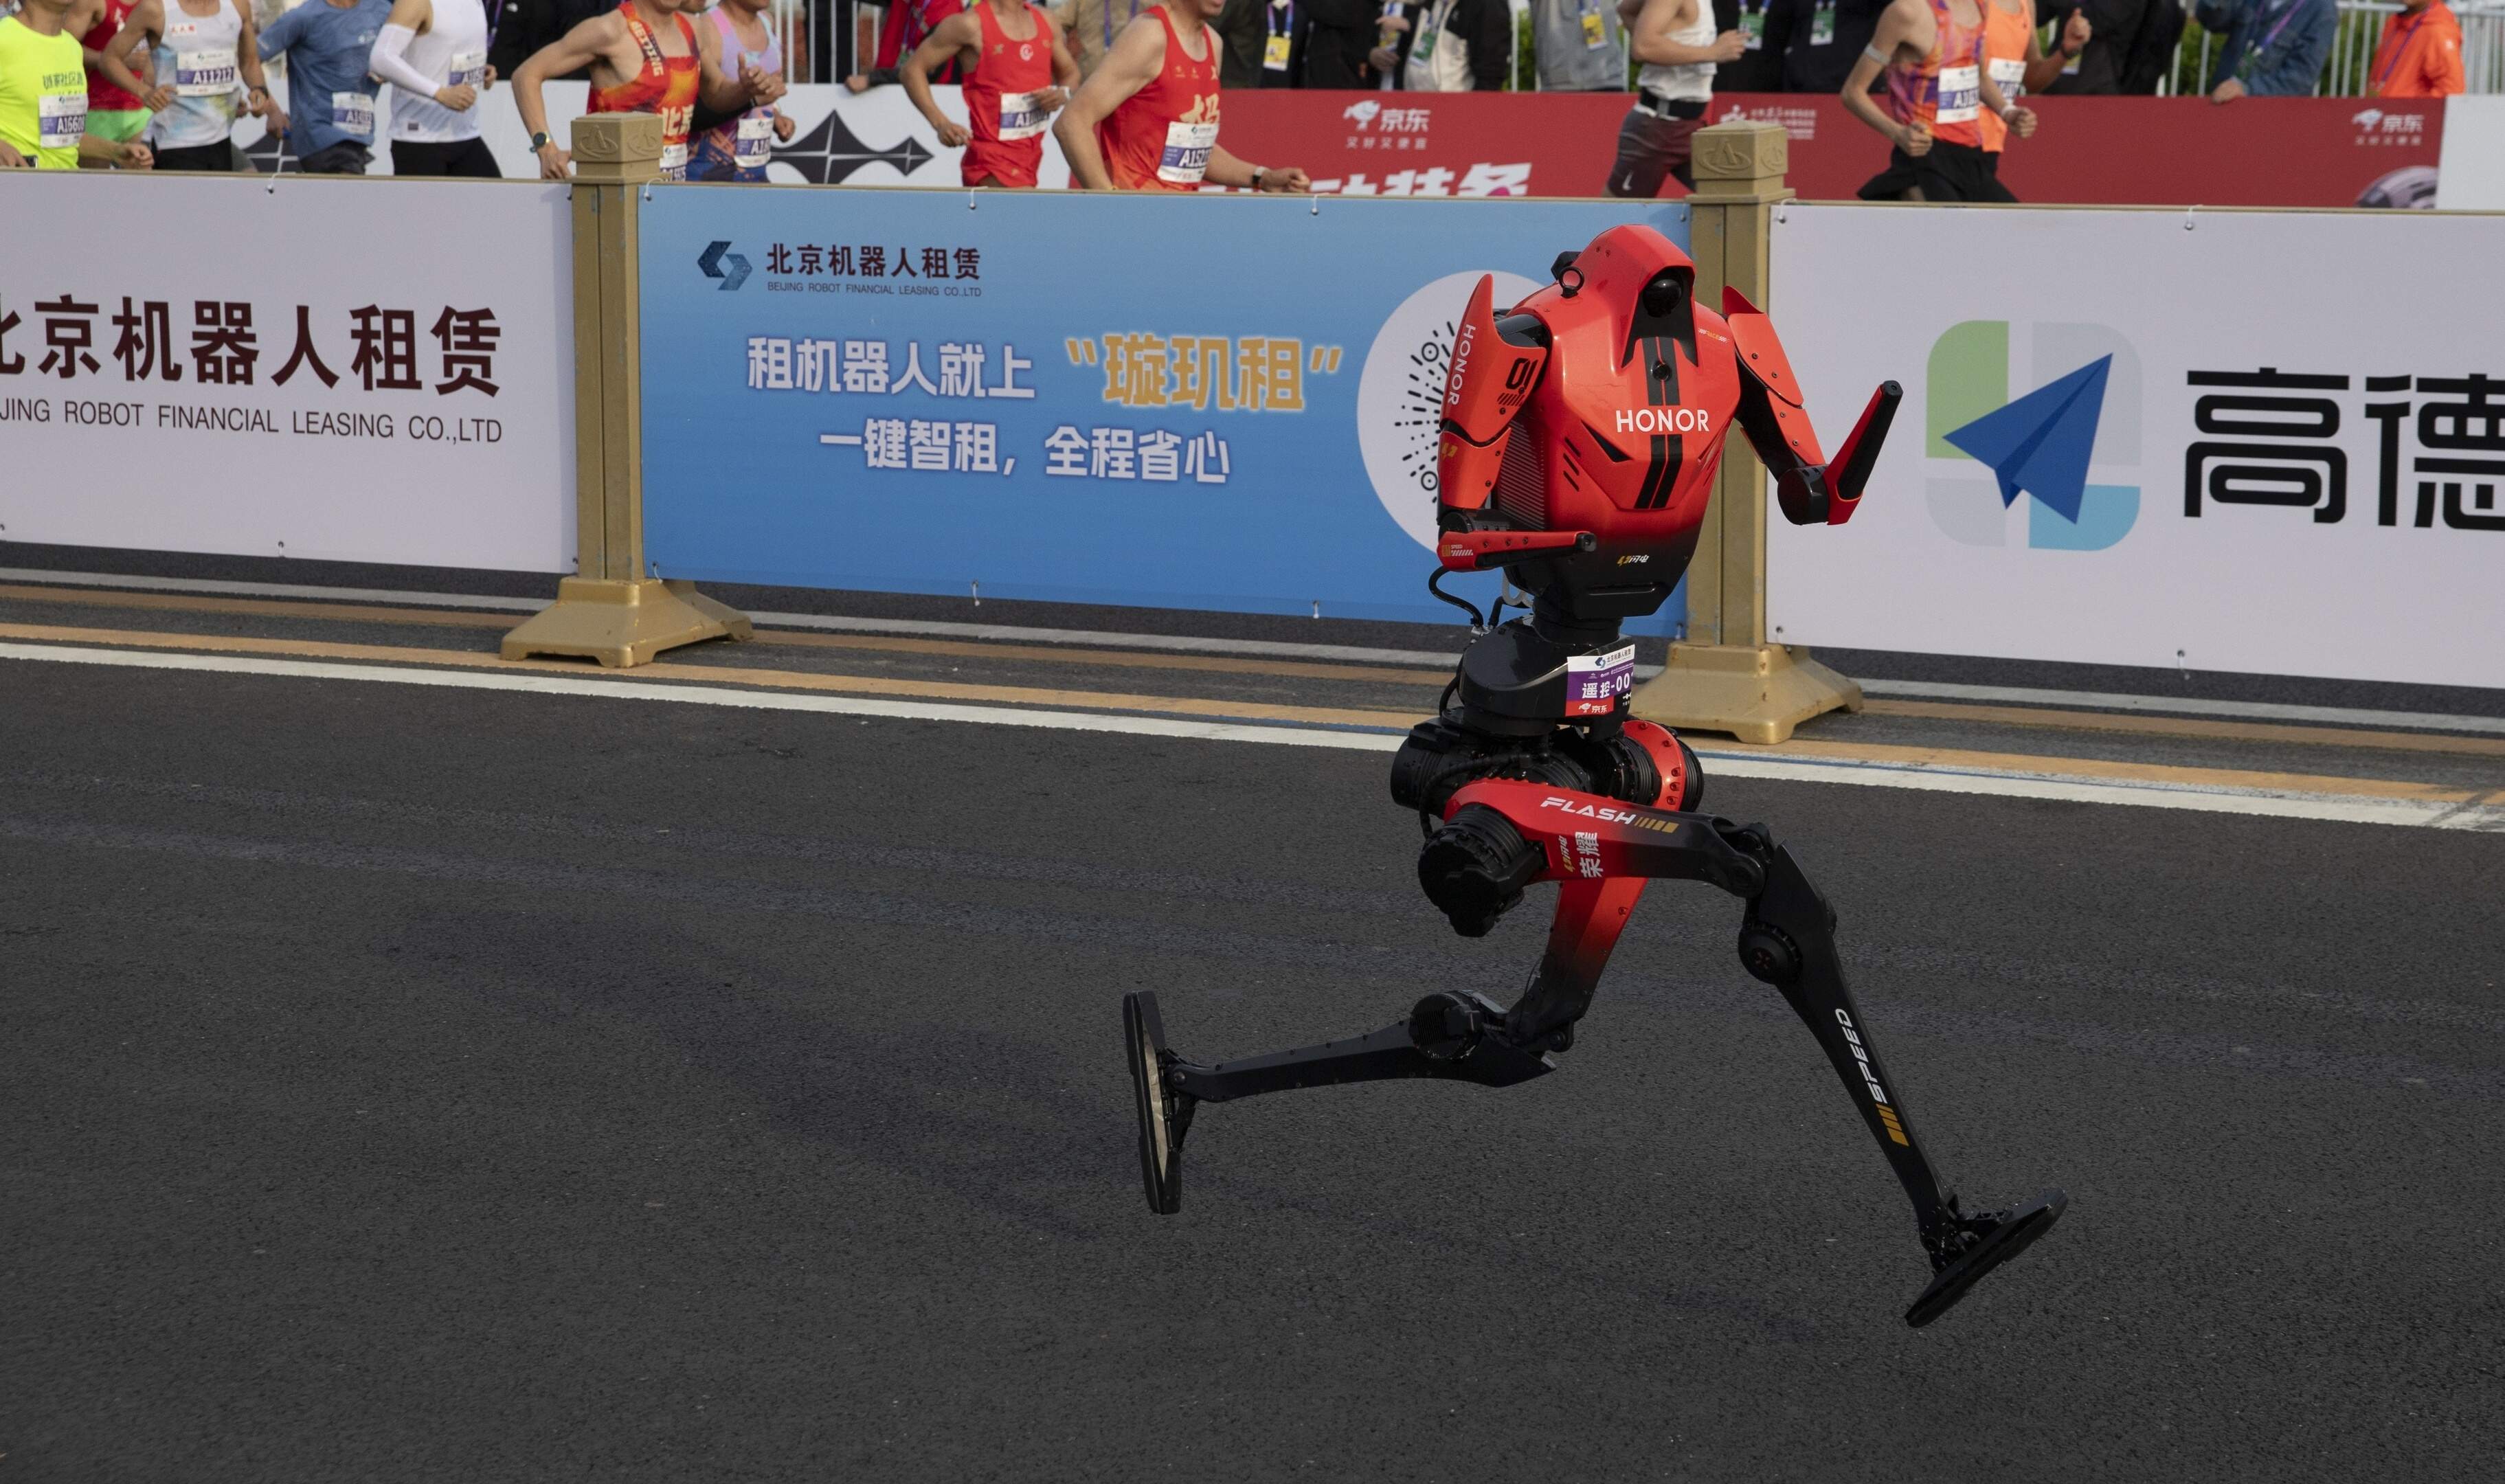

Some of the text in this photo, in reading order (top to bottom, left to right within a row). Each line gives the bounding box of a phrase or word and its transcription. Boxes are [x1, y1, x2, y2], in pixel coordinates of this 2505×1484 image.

[1380, 109, 1430, 132] 京东
[766, 243, 981, 280] 北京机器人租赁
[767, 282, 804, 291] BEIJING
[808, 283, 842, 293] ROBOT
[846, 284, 895, 294] FINANCIAL
[899, 286, 940, 295] LEASING
[747, 336, 1035, 399] 租机器人就上
[1448, 324, 1476, 405] HONOR
[1505, 357, 1532, 390] 01
[65, 401, 144, 426] ROBOT
[158, 405, 279, 433] FINANCIAL
[293, 411, 394, 438] LEASING
[409, 416, 502, 445] CO.,LTD
[1617, 409, 1709, 433] HONOR
[2183, 367, 2505, 530] 高德
[1582, 671, 1633, 699] 遥控-00
[1592, 705, 1607, 713] 京东
[1540, 796, 1637, 824] FLASH
[1575, 831, 1604, 878] 荣耀
[1835, 1008, 1888, 1104] SPEED
